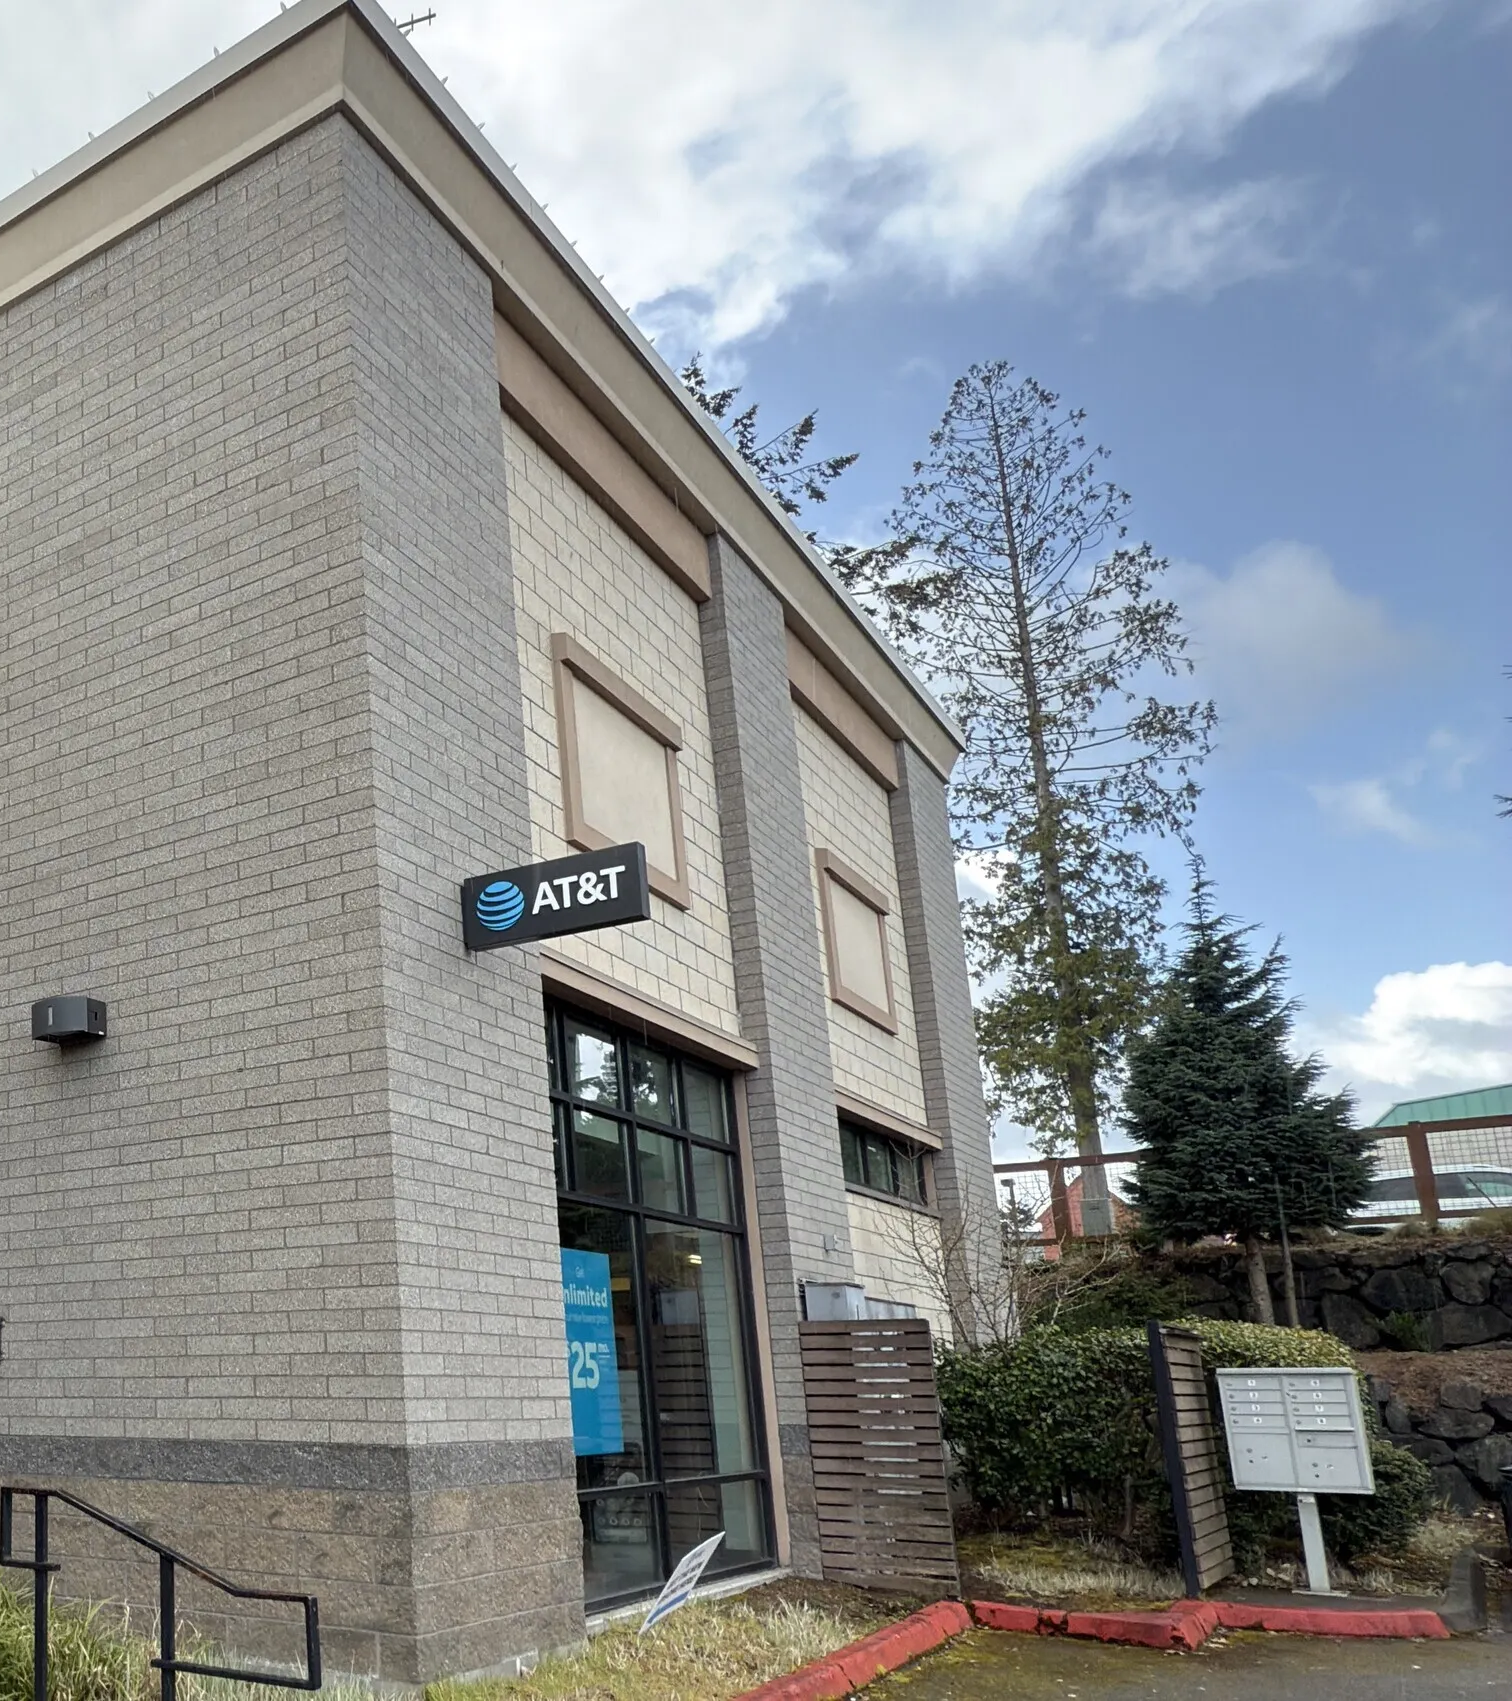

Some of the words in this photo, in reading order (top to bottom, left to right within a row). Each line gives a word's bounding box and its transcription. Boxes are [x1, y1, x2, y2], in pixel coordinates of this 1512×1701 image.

[532, 865, 626, 915] AT&T
[563, 1283, 608, 1308] nlimited
[568, 1340, 600, 1389] 25
